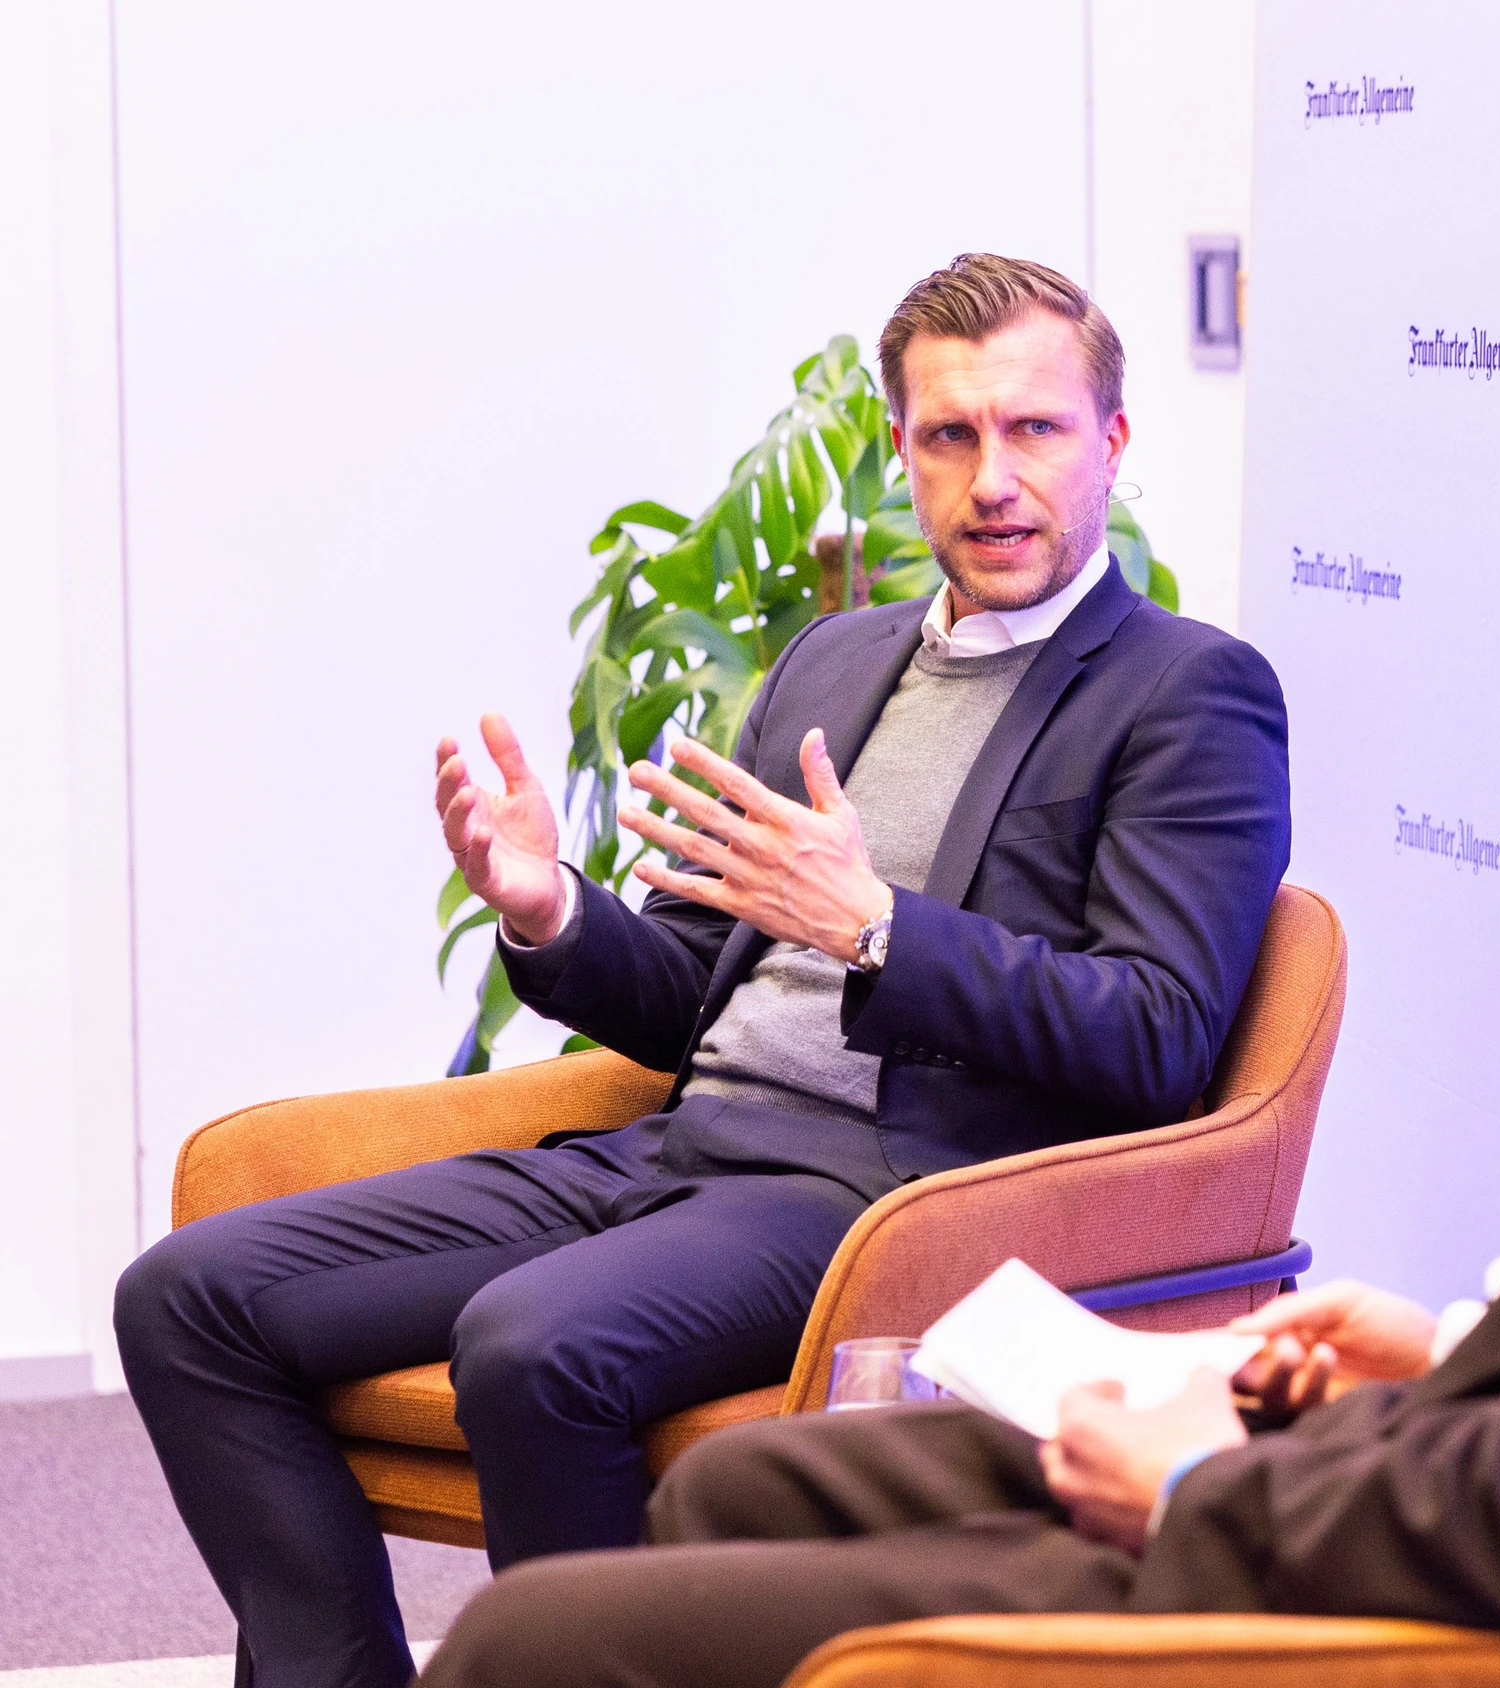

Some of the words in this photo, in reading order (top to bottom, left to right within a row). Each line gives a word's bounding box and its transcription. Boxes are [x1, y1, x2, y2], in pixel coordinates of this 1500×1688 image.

[1304, 80, 1359, 130] Frankfurter
[1359, 74, 1415, 126] Allgemeine
[1408, 324, 1469, 377] Frankfurter
[1291, 546, 1346, 596] Frankfurter
[1346, 553, 1402, 605] Allgemeine
[1394, 803, 1455, 859] Frankfurter
